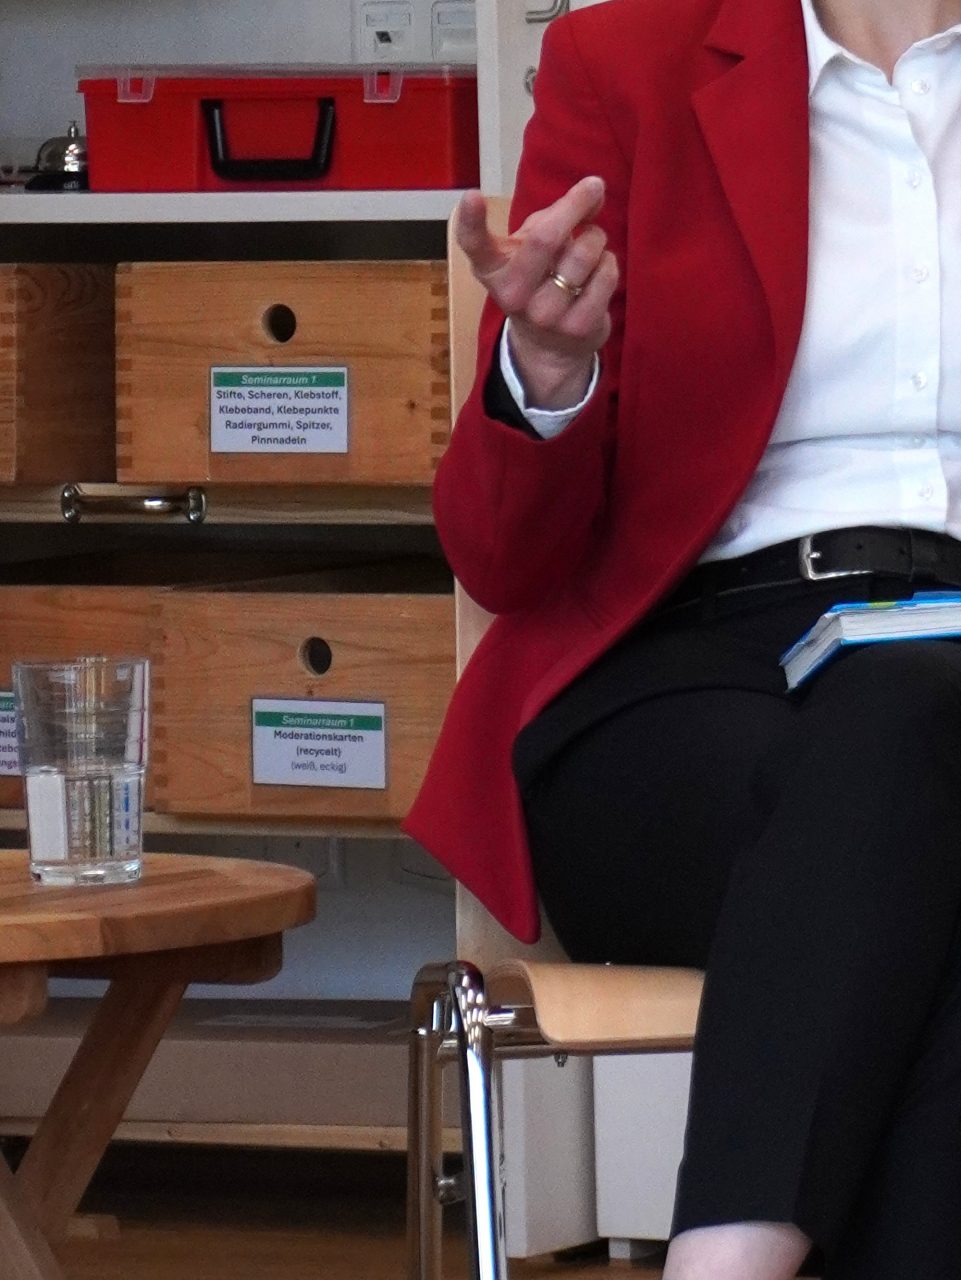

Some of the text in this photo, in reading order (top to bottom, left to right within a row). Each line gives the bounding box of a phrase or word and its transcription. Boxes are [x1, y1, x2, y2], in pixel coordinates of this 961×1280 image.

[241, 374, 308, 385] Seminarraum
[216, 390, 342, 401] Stifte, Scheren, Klebstoff,
[218, 405, 339, 417] Klebeband, Klebepunkte
[225, 420, 333, 432] Radiergummi, Spitzer,
[251, 435, 307, 445] Pinnnadeln
[281, 715, 347, 727] Seminarraum
[273, 729, 364, 743] Moderationskarten
[296, 746, 342, 758] (recycelt)
